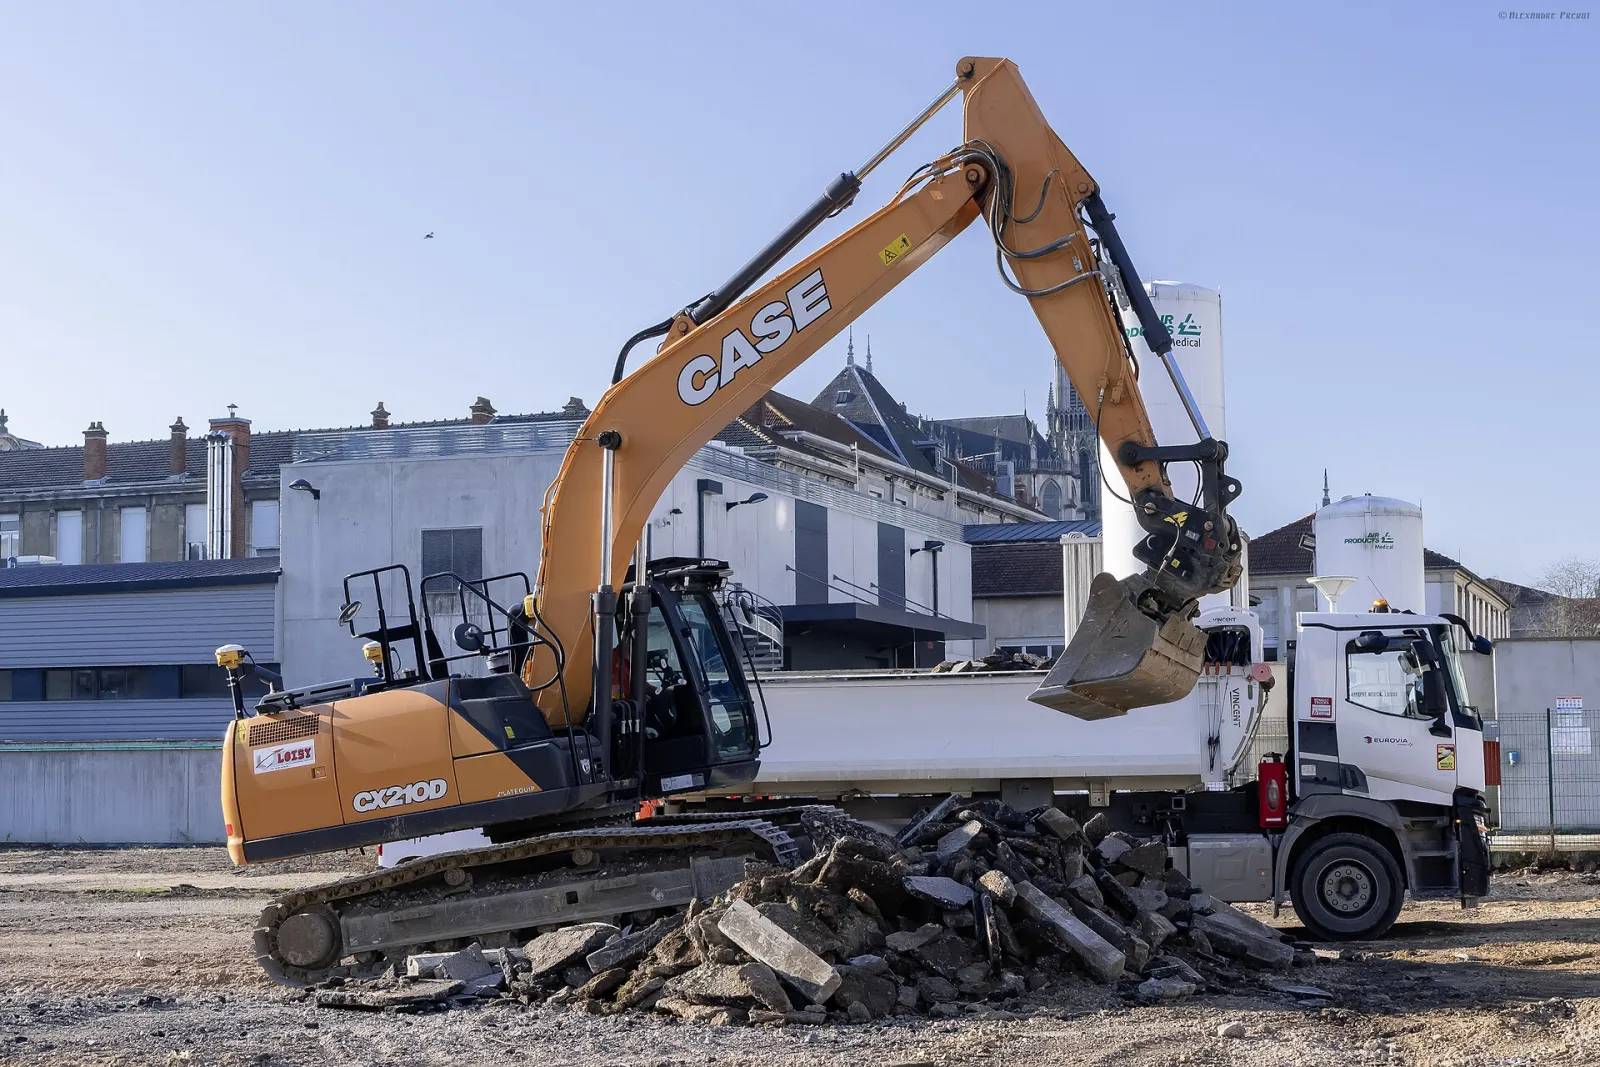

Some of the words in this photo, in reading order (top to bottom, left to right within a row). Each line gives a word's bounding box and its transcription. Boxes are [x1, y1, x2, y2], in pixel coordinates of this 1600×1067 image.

[677, 267, 832, 406] CASE
[1232, 687, 1241, 728] VINCENT
[277, 747, 312, 763] LOISY
[352, 778, 448, 813] CX210D
